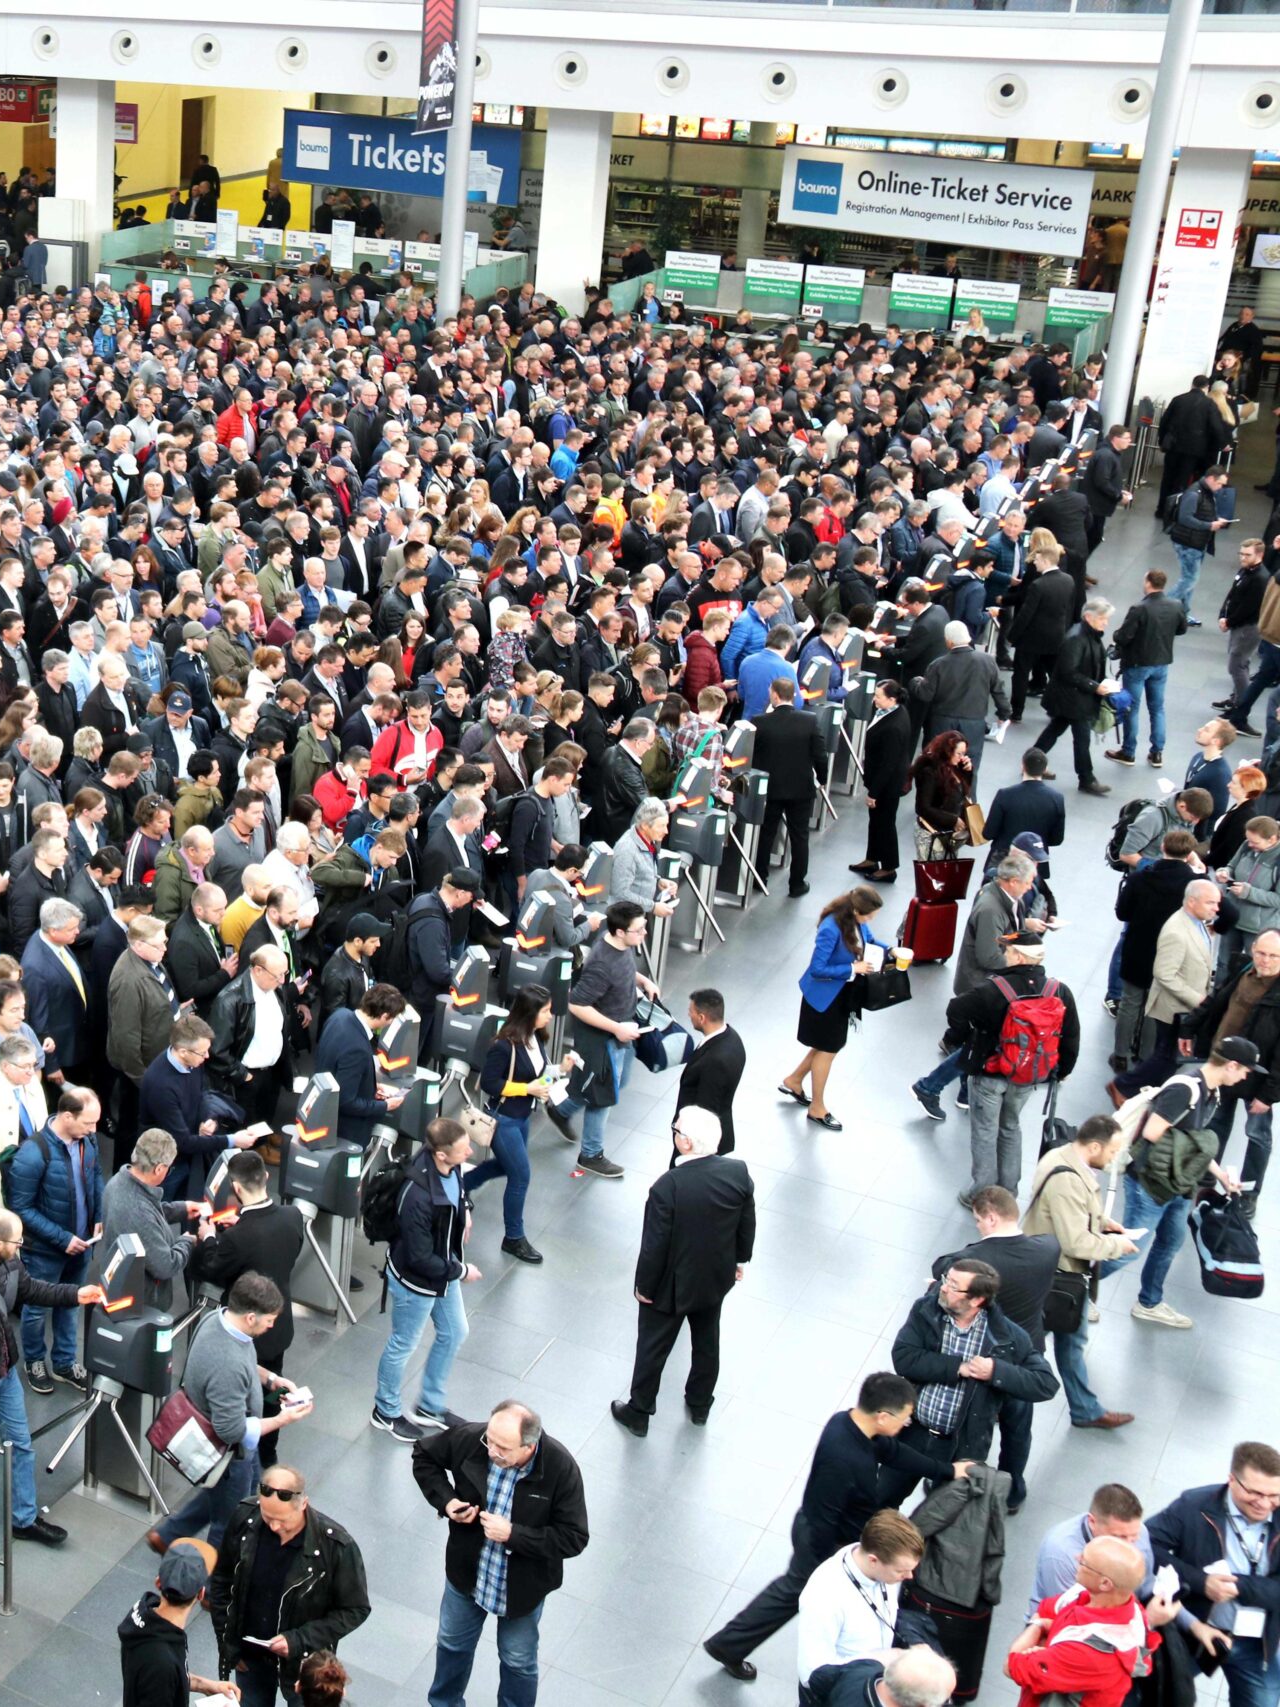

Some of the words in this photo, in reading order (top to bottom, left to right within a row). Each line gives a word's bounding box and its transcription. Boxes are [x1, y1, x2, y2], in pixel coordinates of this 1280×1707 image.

[418, 84, 442, 100] POWER
[443, 82, 454, 97] UP
[300, 140, 328, 153] bauma
[348, 132, 446, 176] Tickets
[798, 178, 837, 195] bauma
[858, 170, 988, 202] Online-Ticket
[994, 183, 1072, 211] Service
[1091, 189, 1136, 203] MARK
[846, 200, 897, 215] Registration
[900, 206, 960, 222] Management
[968, 214, 1009, 227] Exhibitor
[1012, 220, 1034, 230] Pass
[1037, 221, 1077, 235] Services
